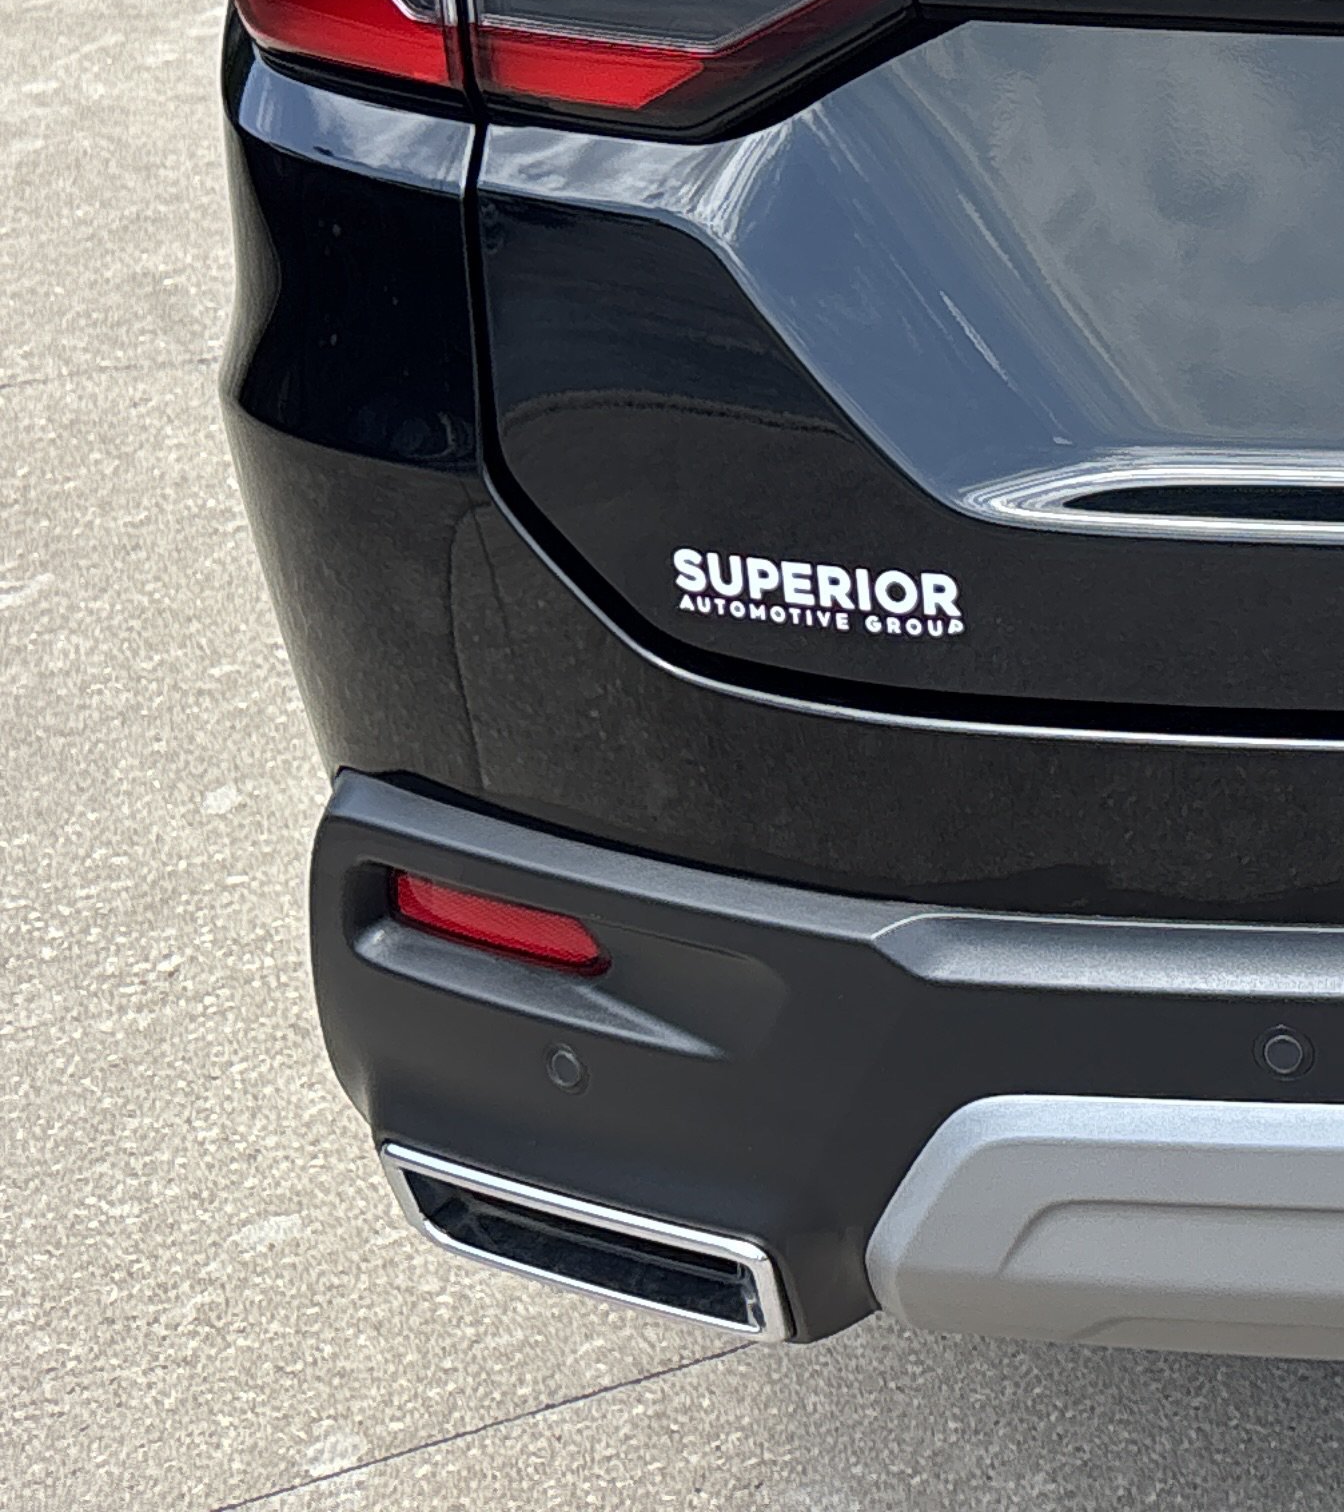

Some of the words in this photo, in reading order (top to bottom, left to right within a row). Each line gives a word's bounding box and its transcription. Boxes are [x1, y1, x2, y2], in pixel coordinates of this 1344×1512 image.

[673, 548, 962, 617] SUPERIOR
[679, 594, 850, 631] AUTOMOTIVE
[864, 614, 965, 637] GROUP
